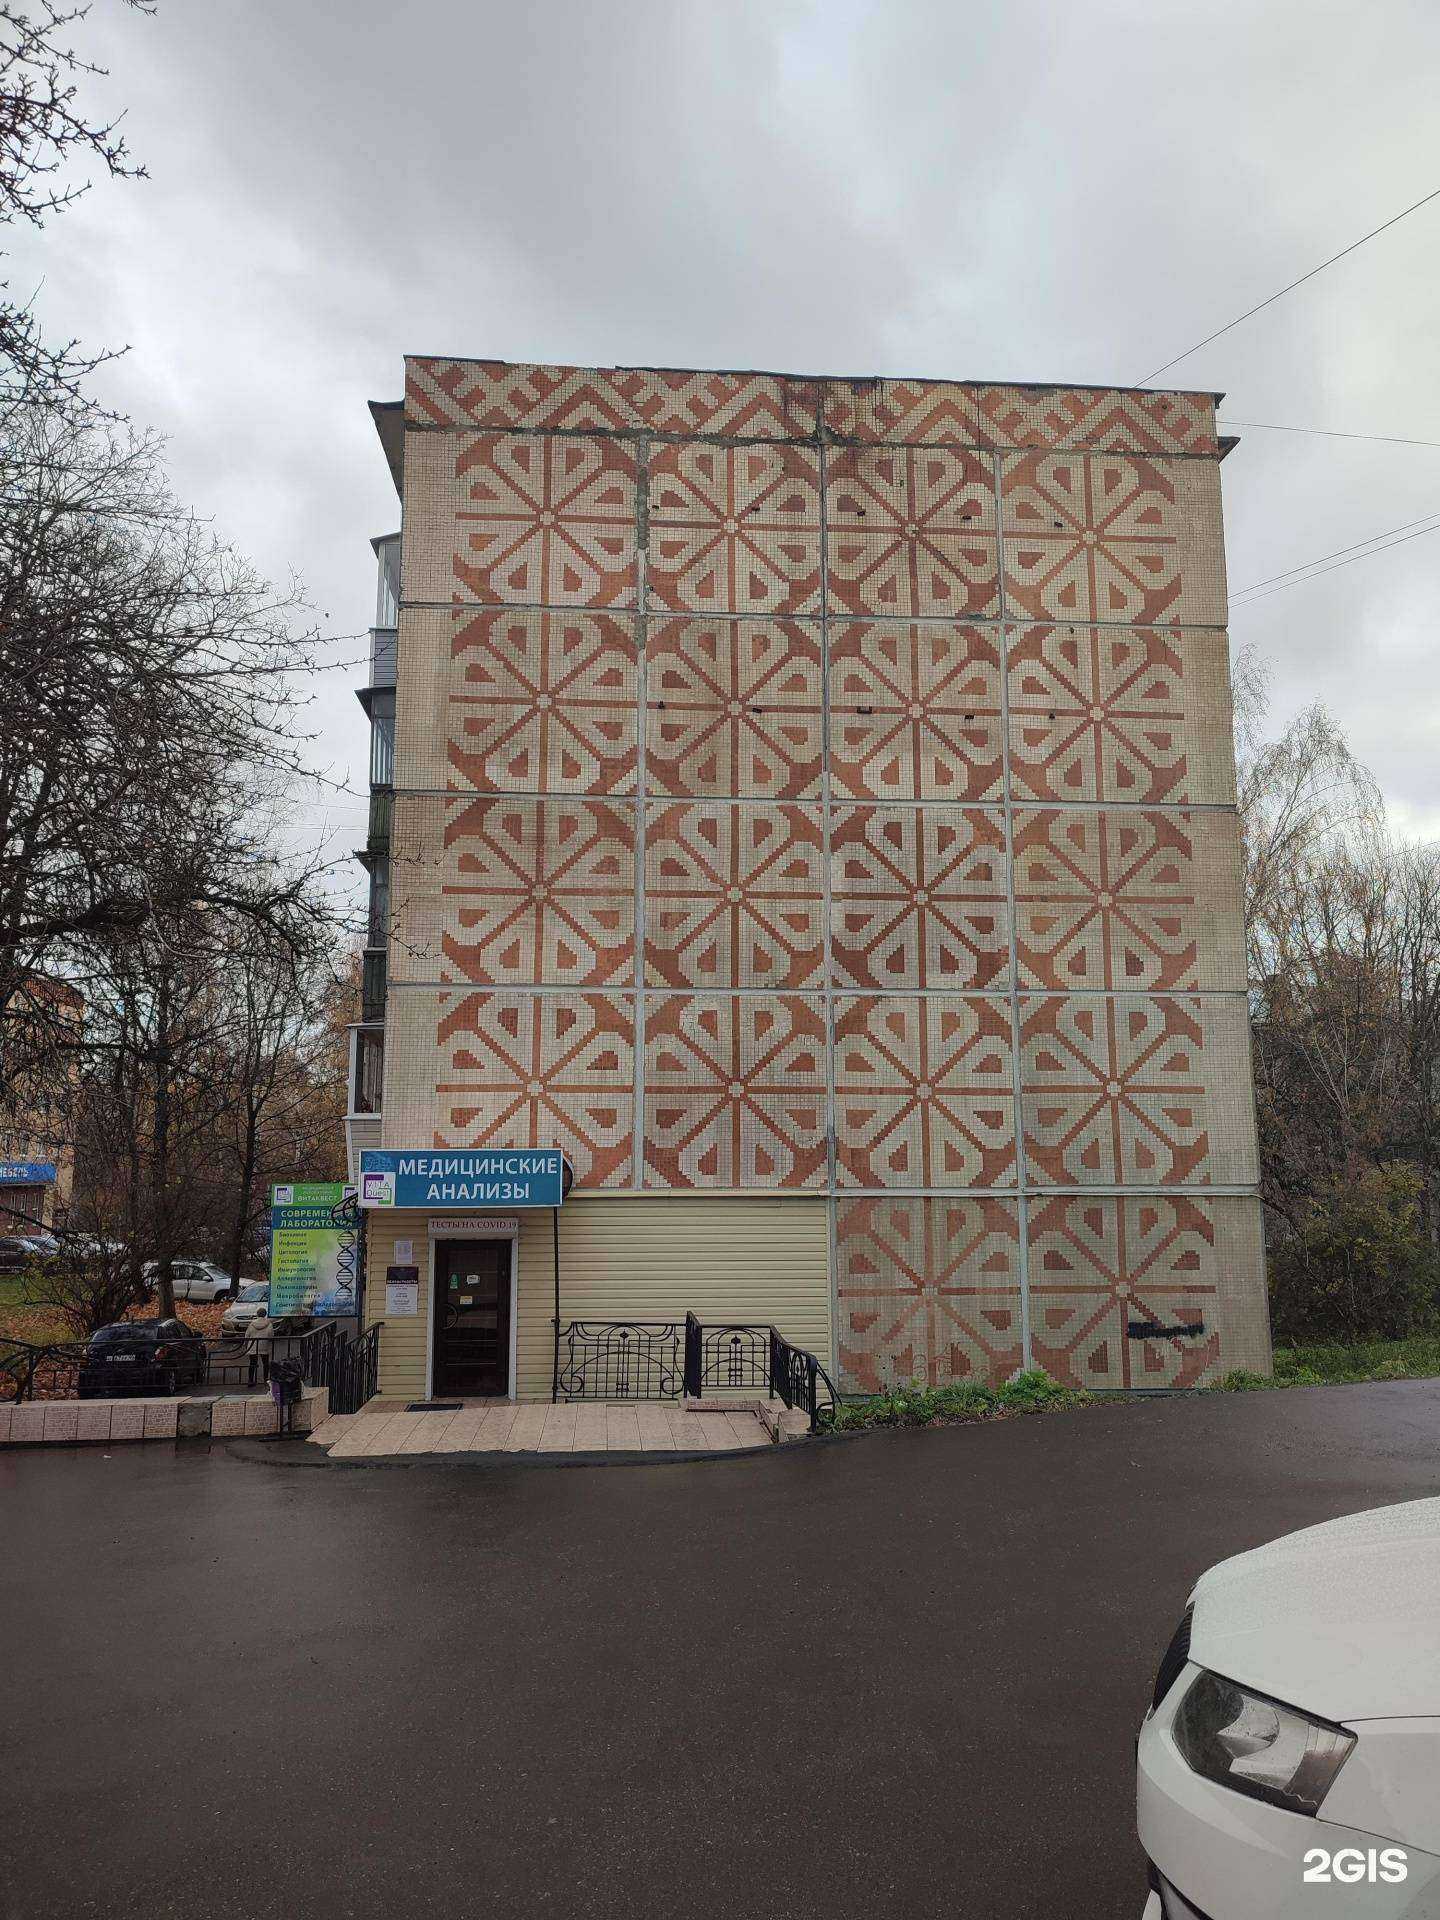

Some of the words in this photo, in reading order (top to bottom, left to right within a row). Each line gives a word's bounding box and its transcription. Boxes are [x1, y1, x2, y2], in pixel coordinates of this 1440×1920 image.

[398, 1158, 557, 1178] МЕДИЦИНСКИЕ
[427, 1183, 529, 1200] АНАЛИЗЫ
[432, 1221, 460, 1229] ТЕСТЫ
[462, 1221, 476, 1229] НА
